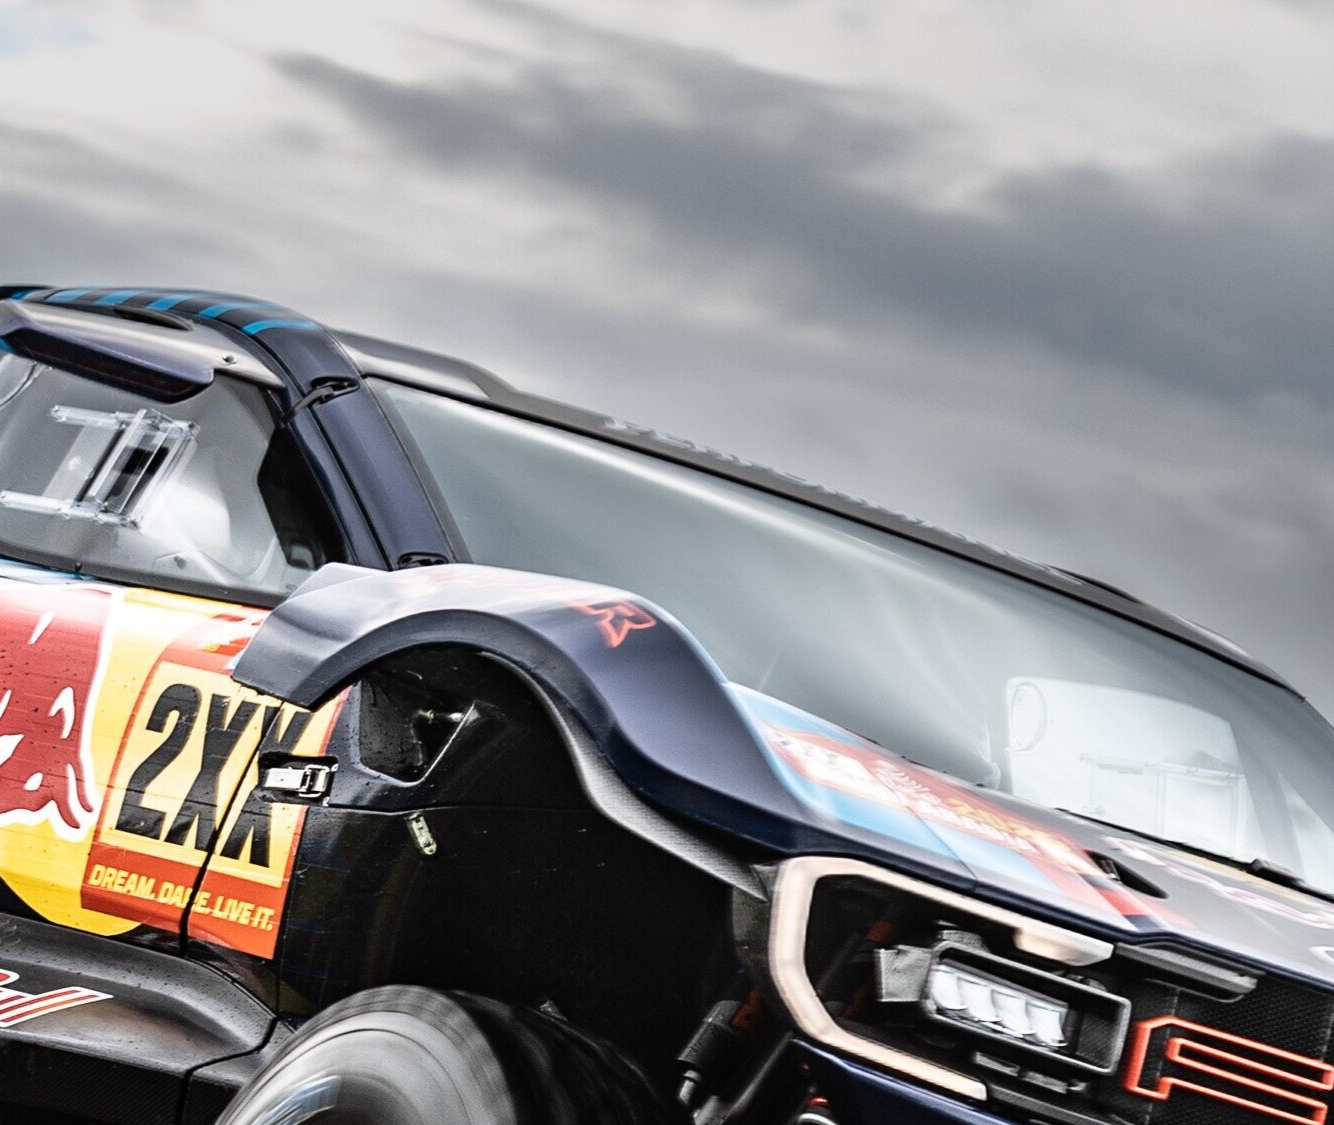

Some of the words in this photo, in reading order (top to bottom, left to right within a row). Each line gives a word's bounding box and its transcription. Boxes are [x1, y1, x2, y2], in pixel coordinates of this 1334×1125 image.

[115, 683, 313, 868] 2XX
[87, 864, 155, 901] DREAM.
[212, 896, 255, 923] LIVE
[252, 906, 275, 931] IT.
